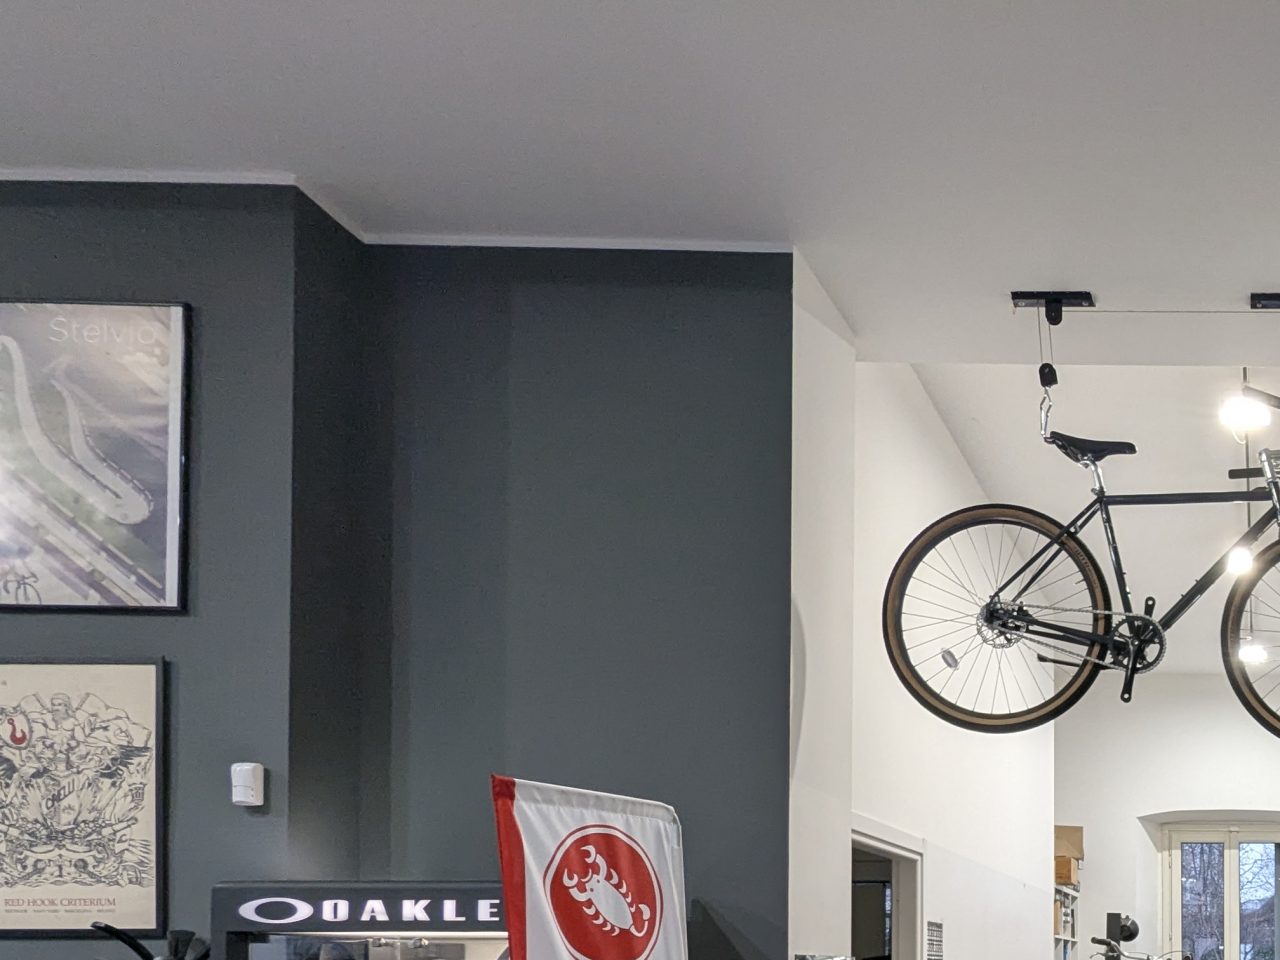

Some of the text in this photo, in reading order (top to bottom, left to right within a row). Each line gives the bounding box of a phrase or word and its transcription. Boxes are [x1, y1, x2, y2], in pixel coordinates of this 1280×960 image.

[48, 317, 156, 345] Stelvio
[4, 897, 117, 907] RED HOOK CRITERIUM
